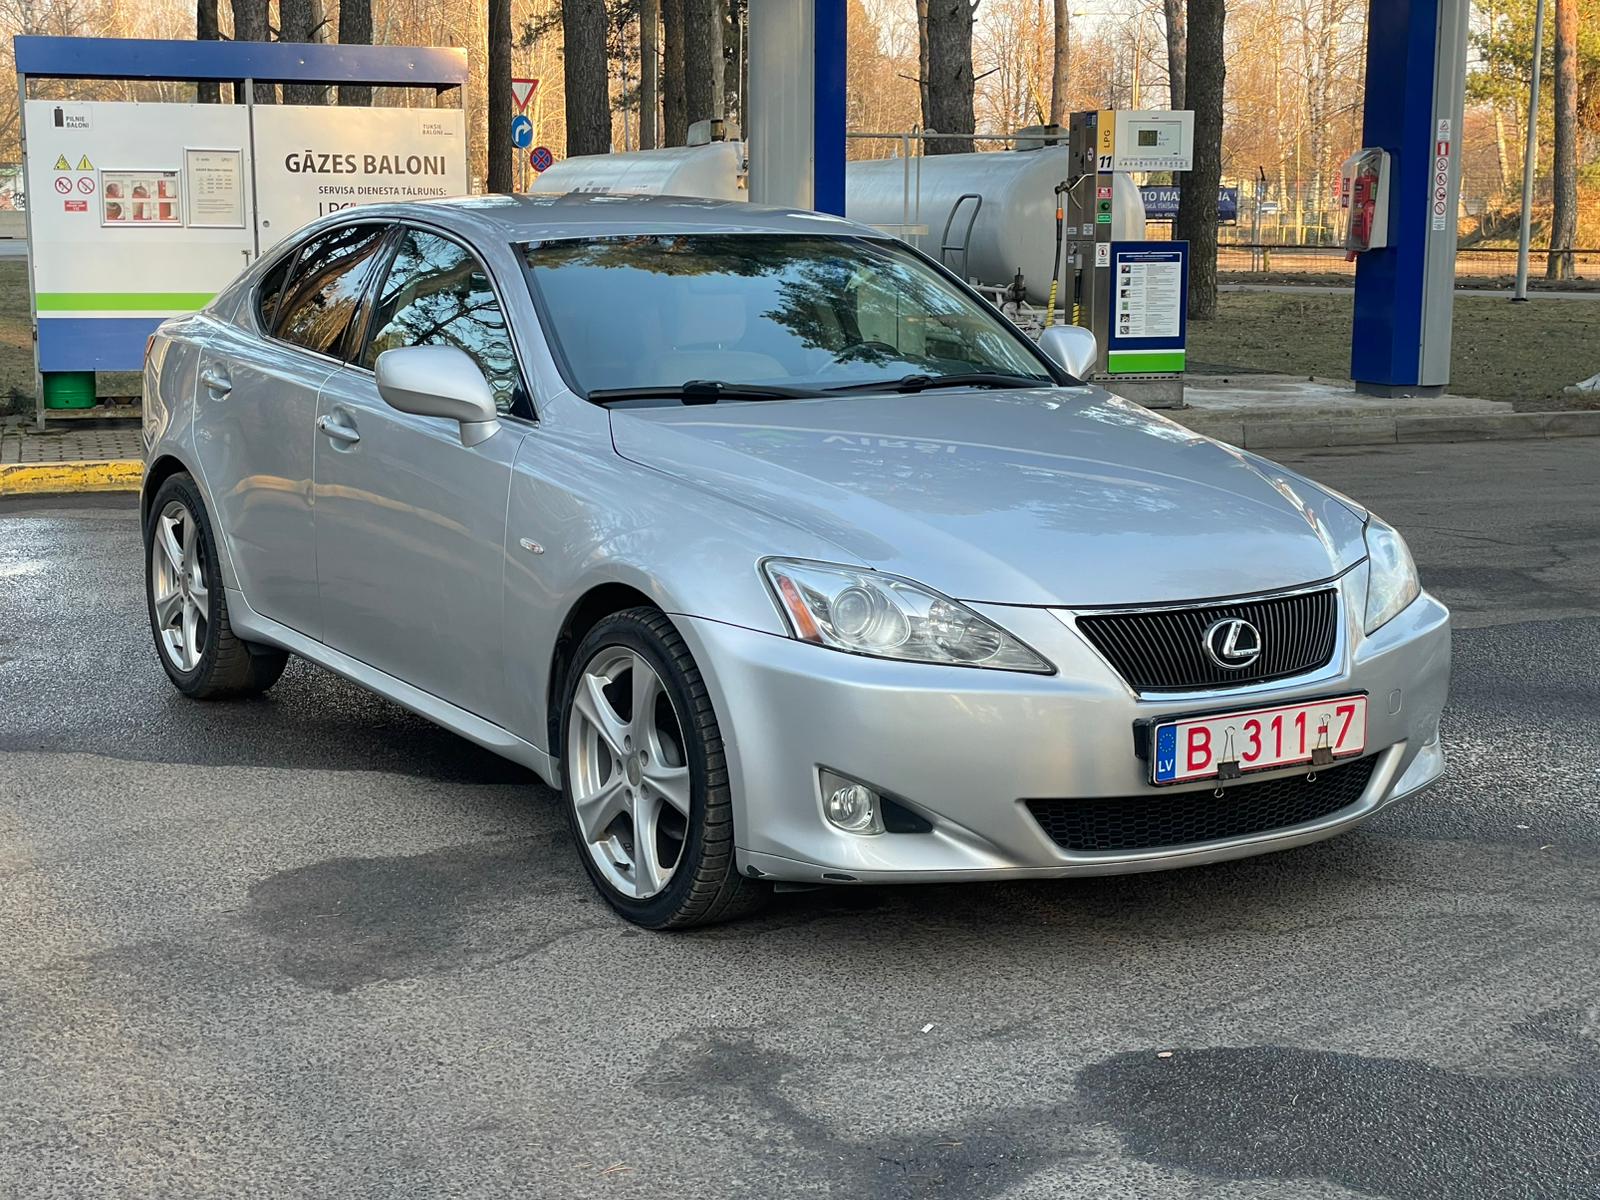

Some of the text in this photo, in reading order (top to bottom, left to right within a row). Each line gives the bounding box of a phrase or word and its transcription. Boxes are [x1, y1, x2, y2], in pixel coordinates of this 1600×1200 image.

[1103, 130, 1111, 148] LPG
[285, 150, 445, 175] GĀZES BALONI
[1099, 155, 1112, 168] 11
[318, 185, 447, 196] SERVISA DIENESTA TĀLRUNIS:
[1141, 191, 1157, 201] TO
[1158, 759, 1174, 773] LV
[1187, 726, 1212, 772] B
